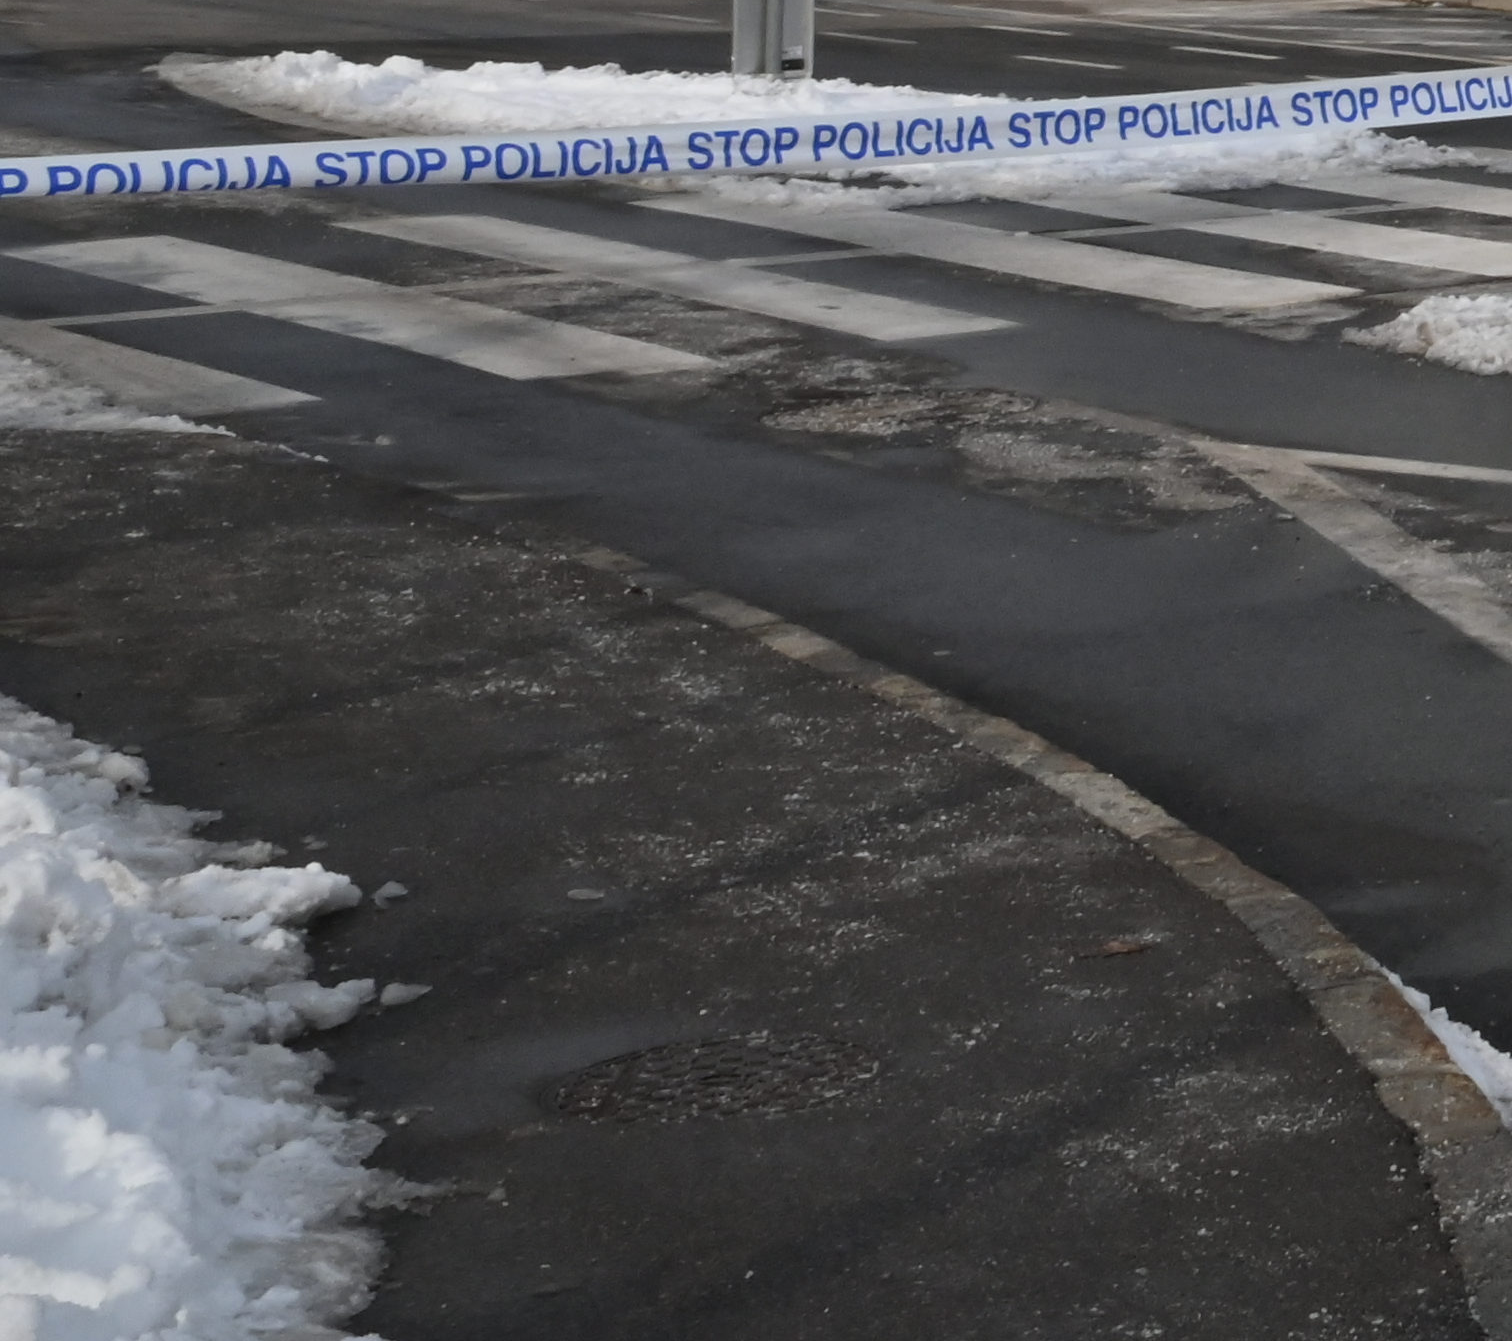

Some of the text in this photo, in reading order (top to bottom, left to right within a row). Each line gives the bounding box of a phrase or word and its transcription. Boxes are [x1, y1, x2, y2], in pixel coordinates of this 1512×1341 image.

[314, 148, 447, 188] STOP
[460, 135, 670, 183] POLICIJA
[687, 126, 798, 171] STOP
[812, 115, 993, 162] POLICIJA
[1007, 108, 1104, 149] STOP
[1118, 95, 1280, 141] POLICIJA
[1290, 86, 1379, 127] STOP
